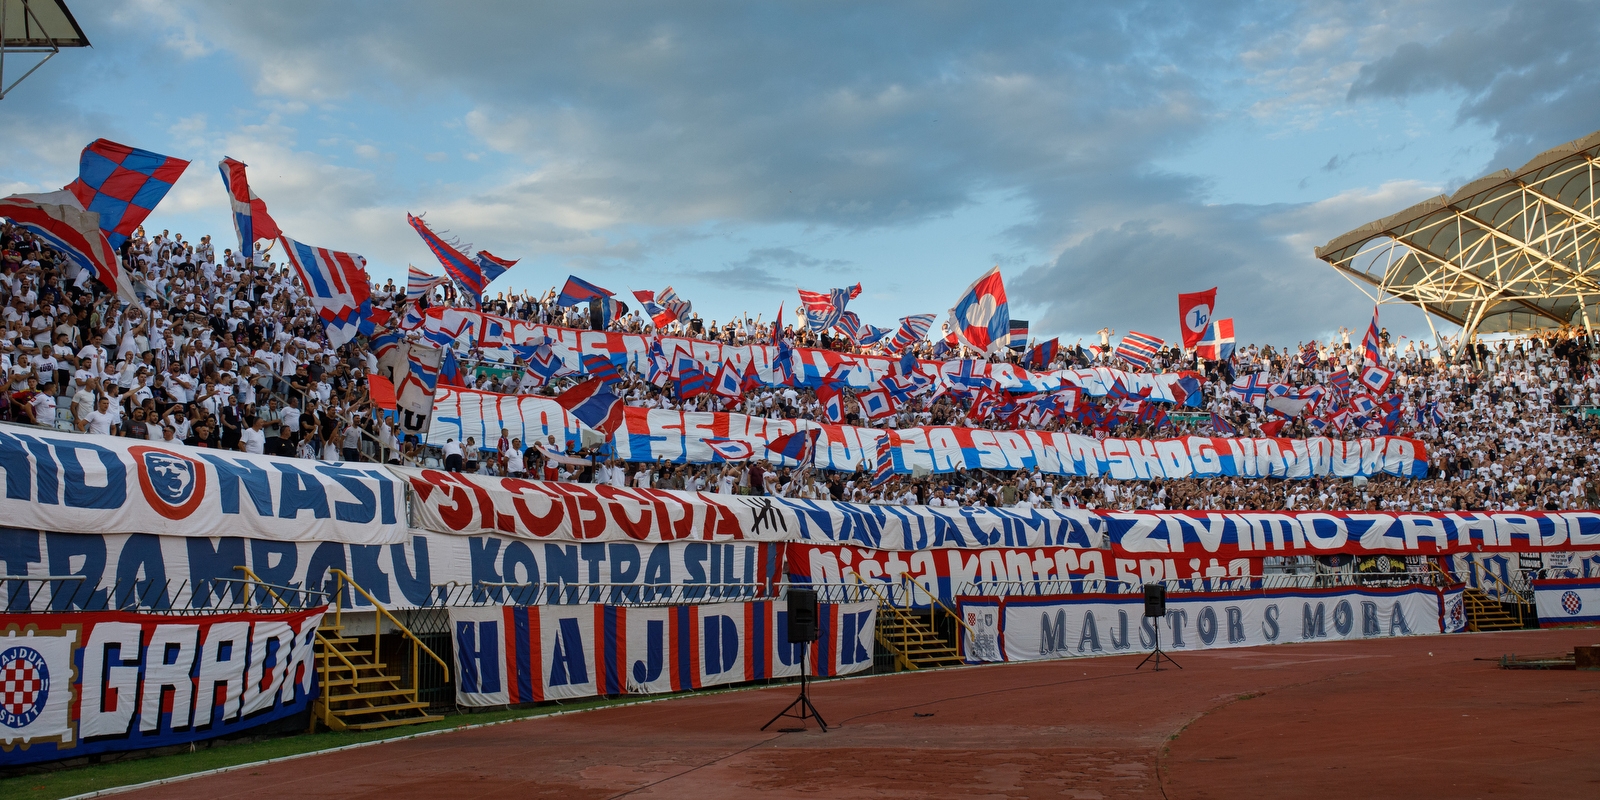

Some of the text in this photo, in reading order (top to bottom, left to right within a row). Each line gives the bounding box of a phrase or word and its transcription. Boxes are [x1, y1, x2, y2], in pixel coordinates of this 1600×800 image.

[900, 427, 967, 473] ZA
[970, 430, 1223, 480] SPLITSKOG
[1231, 437, 1415, 478] HAJDUKA
[199, 451, 397, 525] NAŠI
[410, 469, 1091, 547] SLOBODA NAVIJAČIMA
[1106, 505, 1349, 553] ŽIVIMO
[1347, 513, 1449, 550] ZA
[469, 537, 672, 605] KONTRA
[683, 545, 755, 598] SILI
[1039, 598, 1413, 656] MAJSTOR S MORA
[0, 649, 45, 671] AJDUK
[79, 613, 318, 738] GRADA
[0, 705, 39, 727] SPLIT
